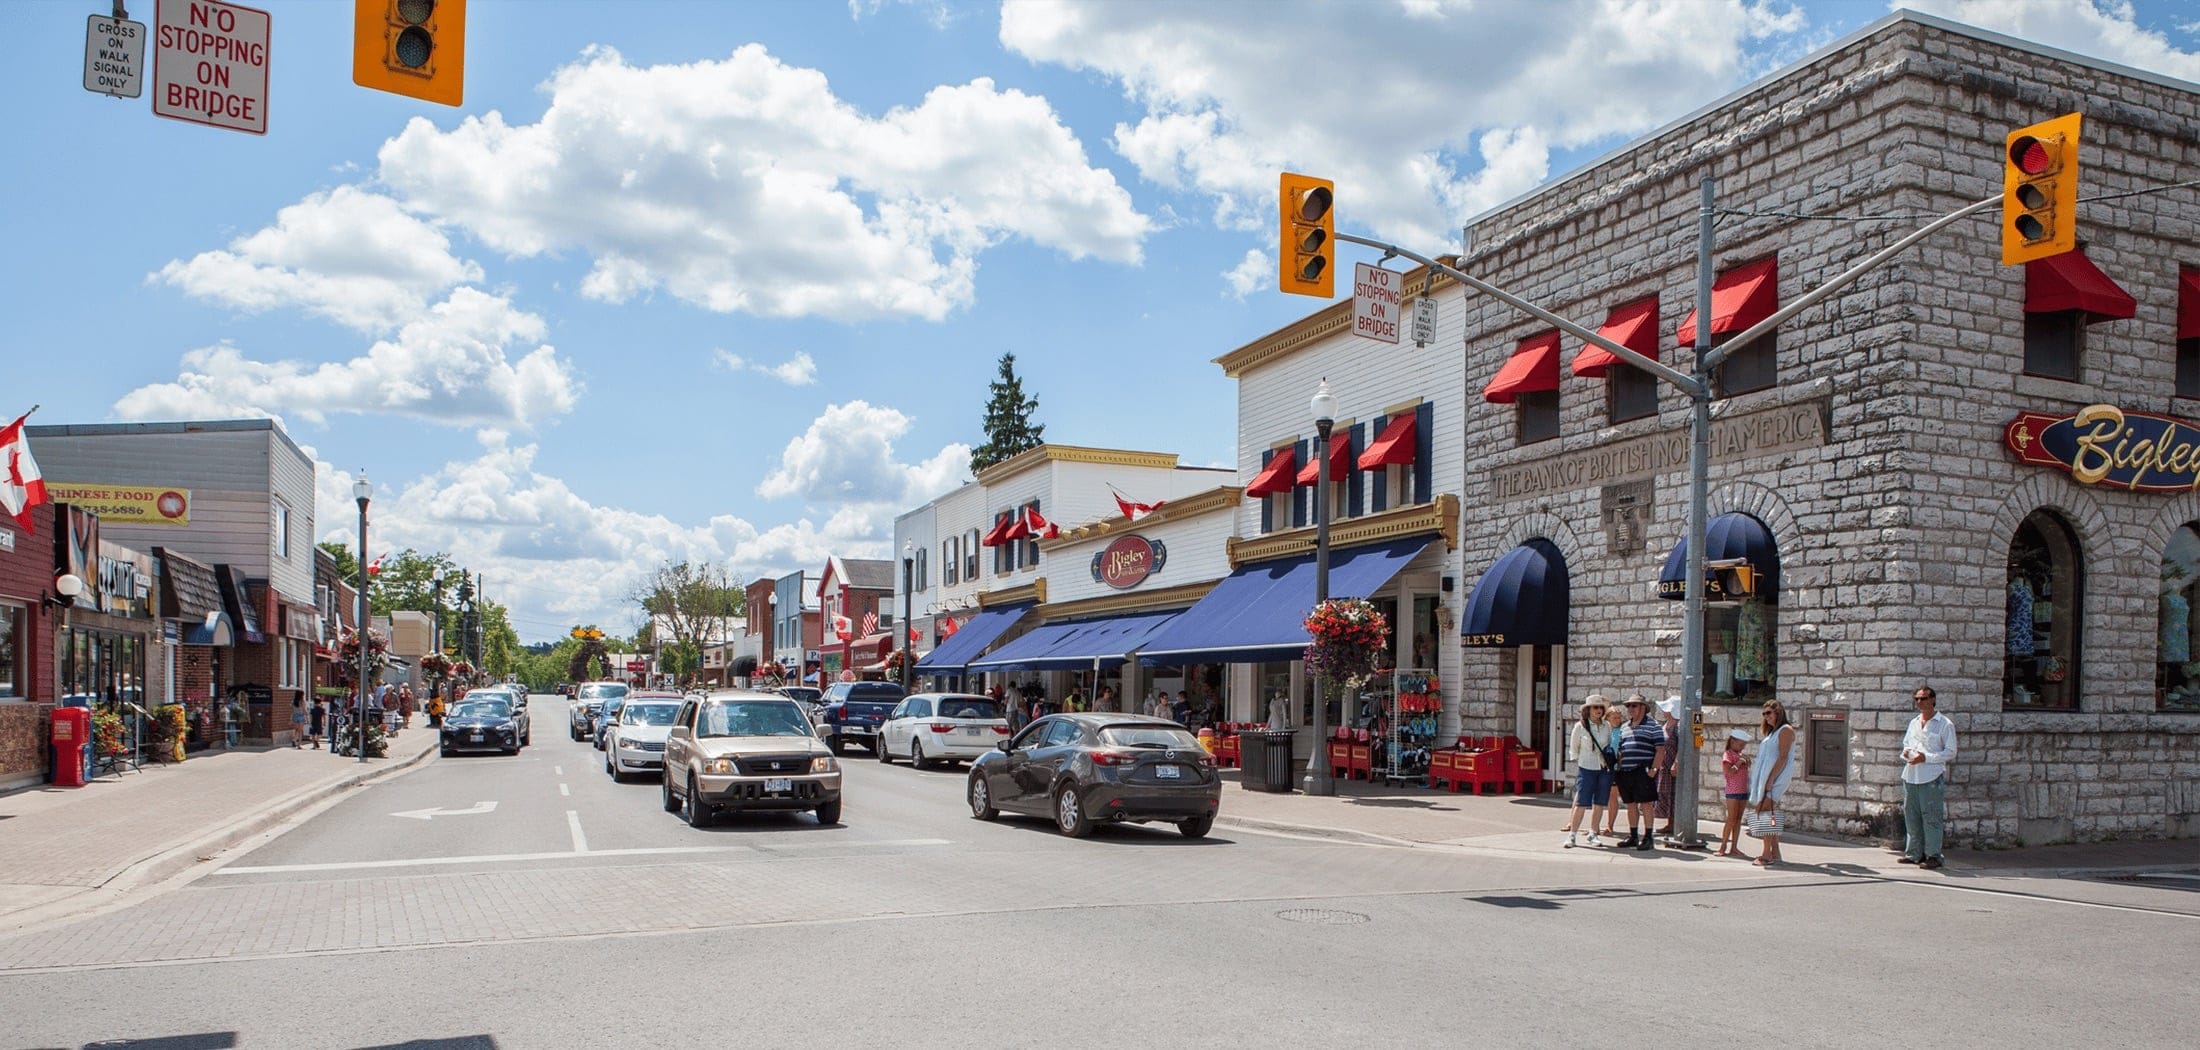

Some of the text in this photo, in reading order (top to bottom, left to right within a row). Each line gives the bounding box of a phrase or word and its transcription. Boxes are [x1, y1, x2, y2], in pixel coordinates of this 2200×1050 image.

[190, 3, 235, 32] NO
[98, 23, 136, 38] CROSS
[107, 37, 124, 50] ON
[160, 25, 263, 67] STOPPING
[99, 48, 131, 64] WALK
[93, 61, 134, 78] SIGNAL
[196, 61, 230, 89] ON
[97, 75, 128, 90] ONLY
[167, 82, 256, 121] BRIDGE
[1370, 270, 1388, 286] NO
[1357, 283, 1399, 305] STOPPING
[1371, 303, 1385, 318] ON
[1418, 301, 1433, 309] CROSS
[1358, 316, 1395, 336] BRIDGE
[1415, 323, 1432, 333] SIGNAL
[1418, 316, 1431, 324] WALK
[1492, 406, 1824, 499] THE BANK OF BRITISH NORH AMERICA
[114, 491, 154, 502] FOOD
[1107, 550, 1145, 580] Bigley
